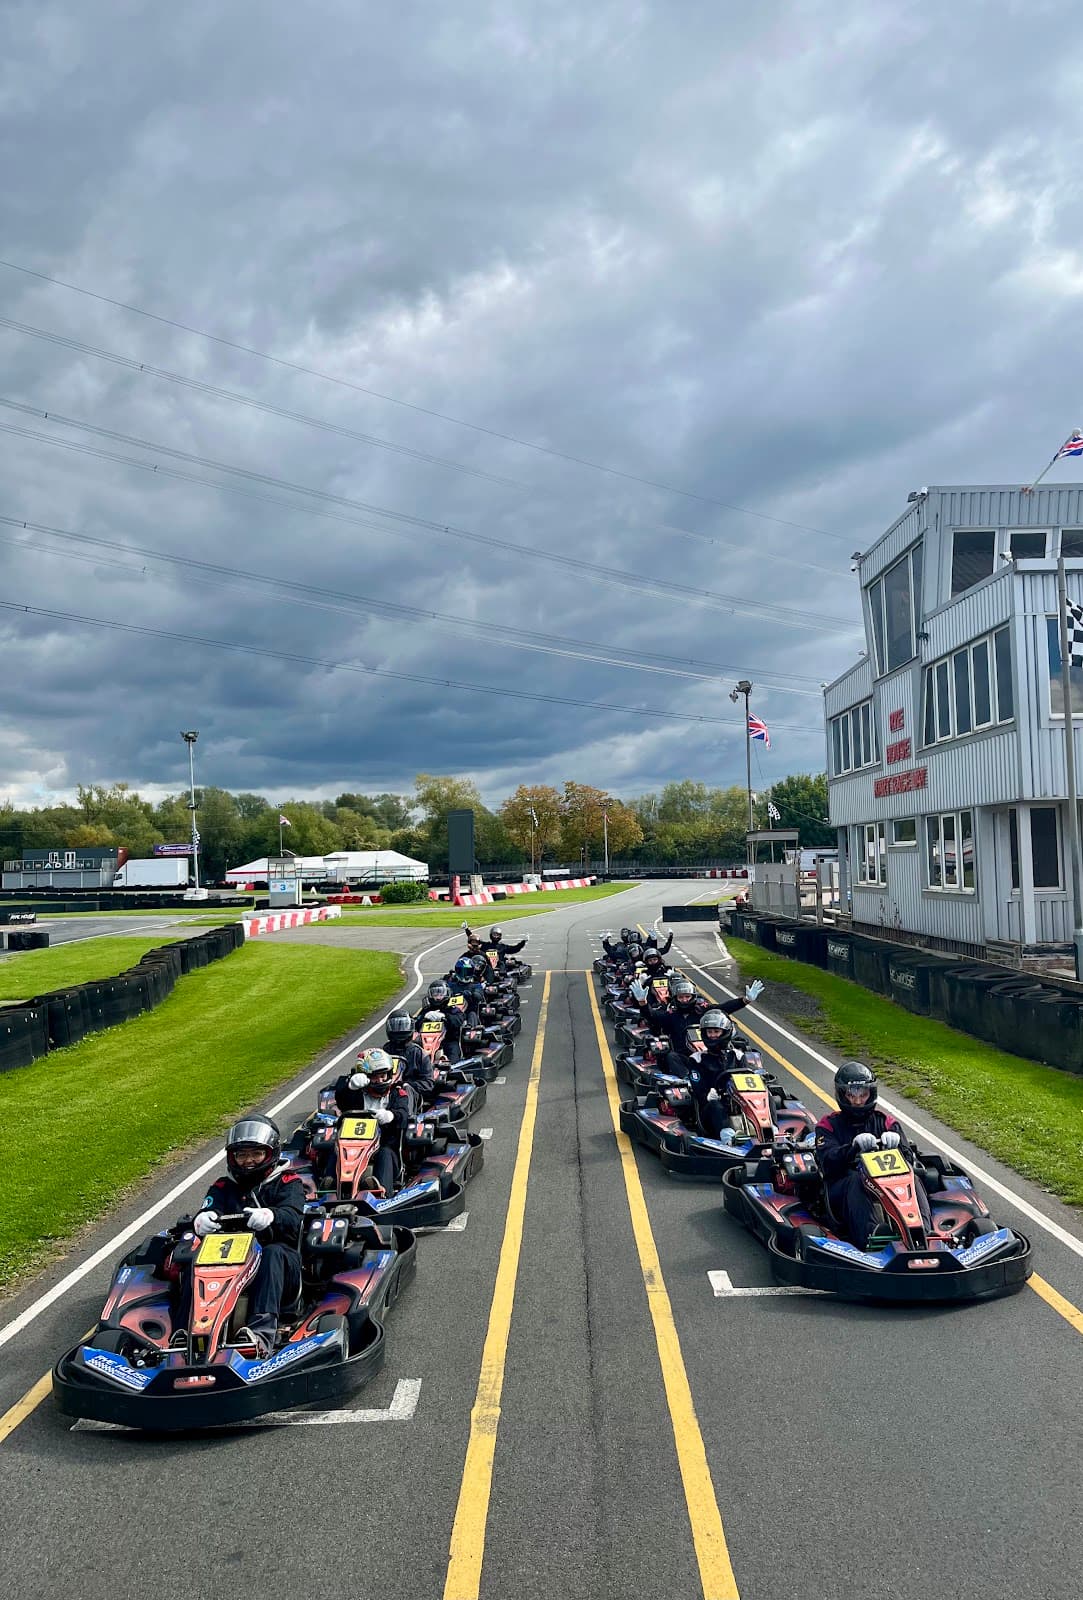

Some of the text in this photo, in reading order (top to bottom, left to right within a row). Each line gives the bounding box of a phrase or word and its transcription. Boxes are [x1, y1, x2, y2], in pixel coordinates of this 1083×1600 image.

[872, 1154, 901, 1171] 12
[219, 1238, 234, 1258] 1
[115, 1364, 151, 1381] HOUSE
